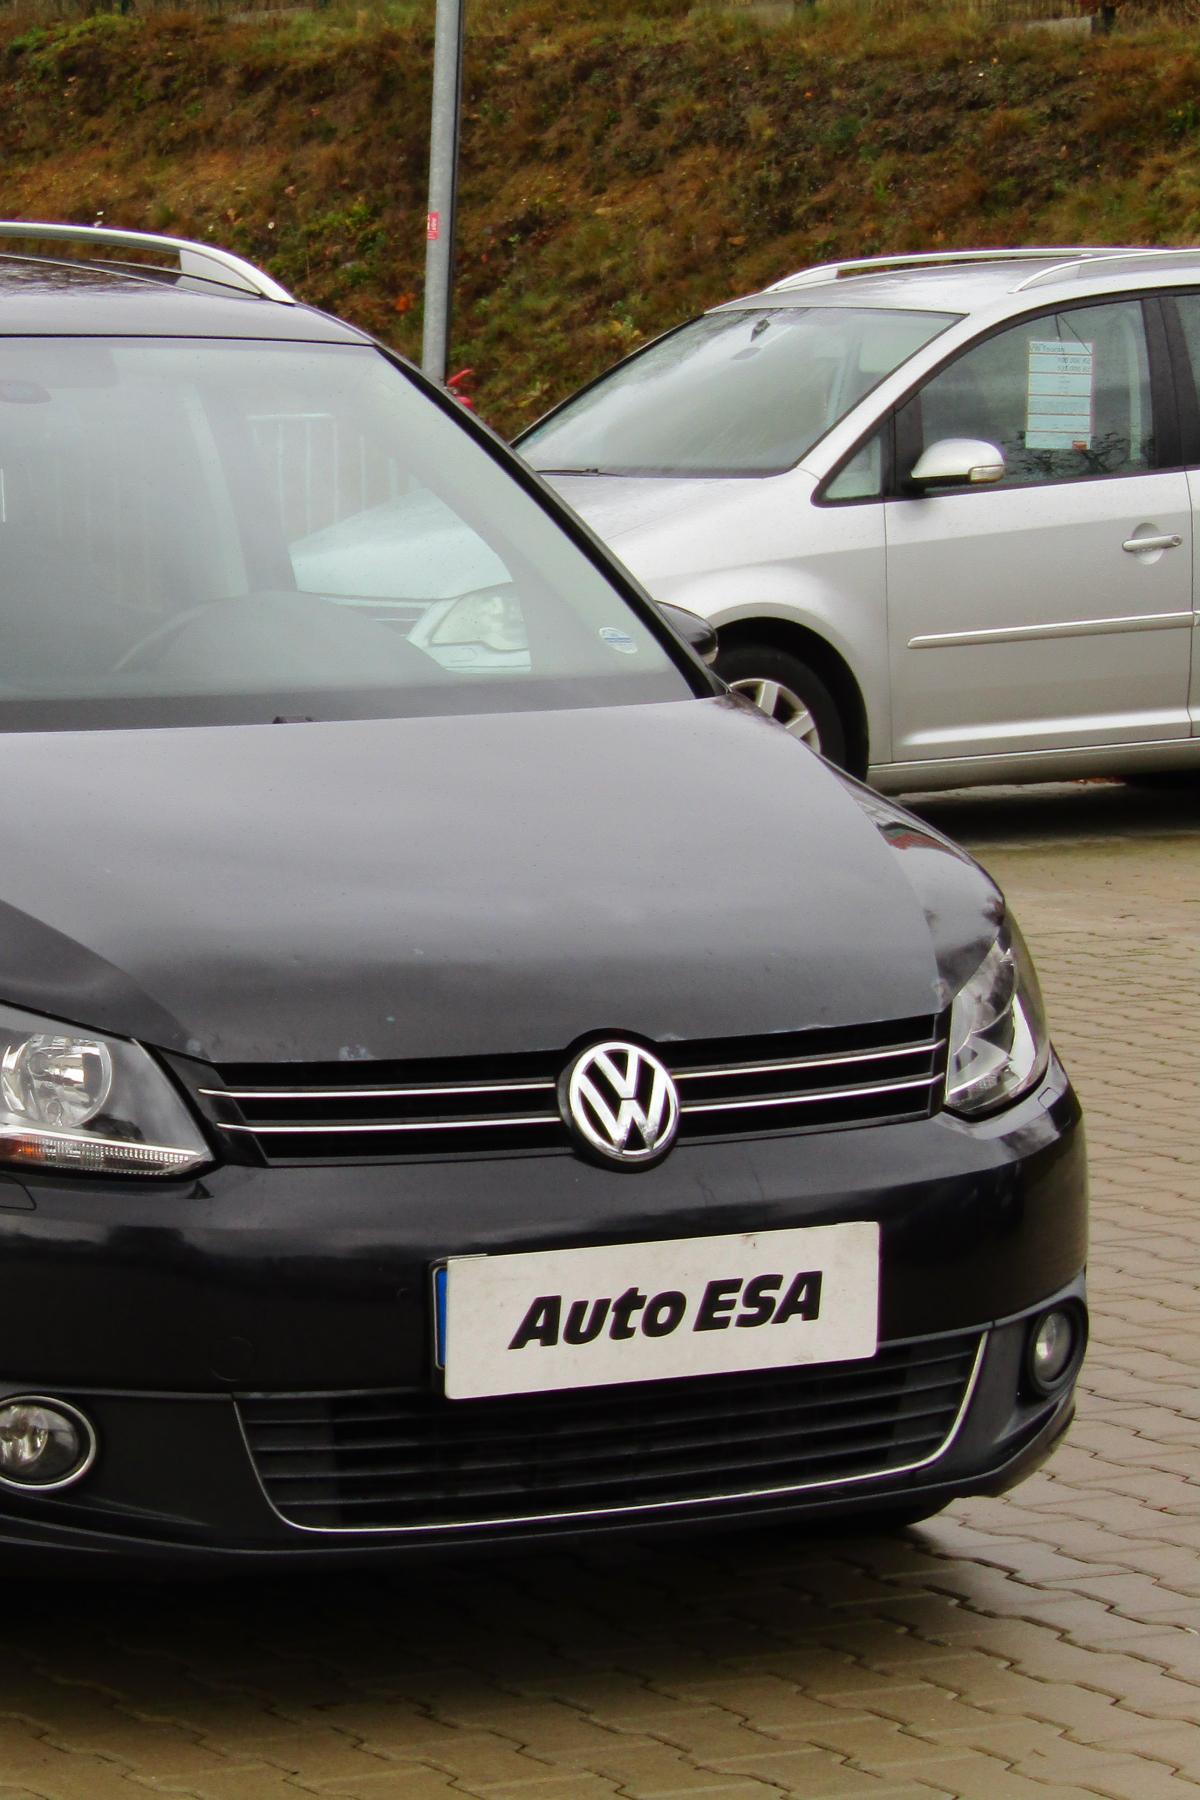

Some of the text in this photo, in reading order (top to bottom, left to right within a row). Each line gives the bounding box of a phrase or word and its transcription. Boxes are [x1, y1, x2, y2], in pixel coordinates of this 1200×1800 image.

[569, 1041, 679, 1161] VW
[507, 1270, 823, 1350] Auto ESA
